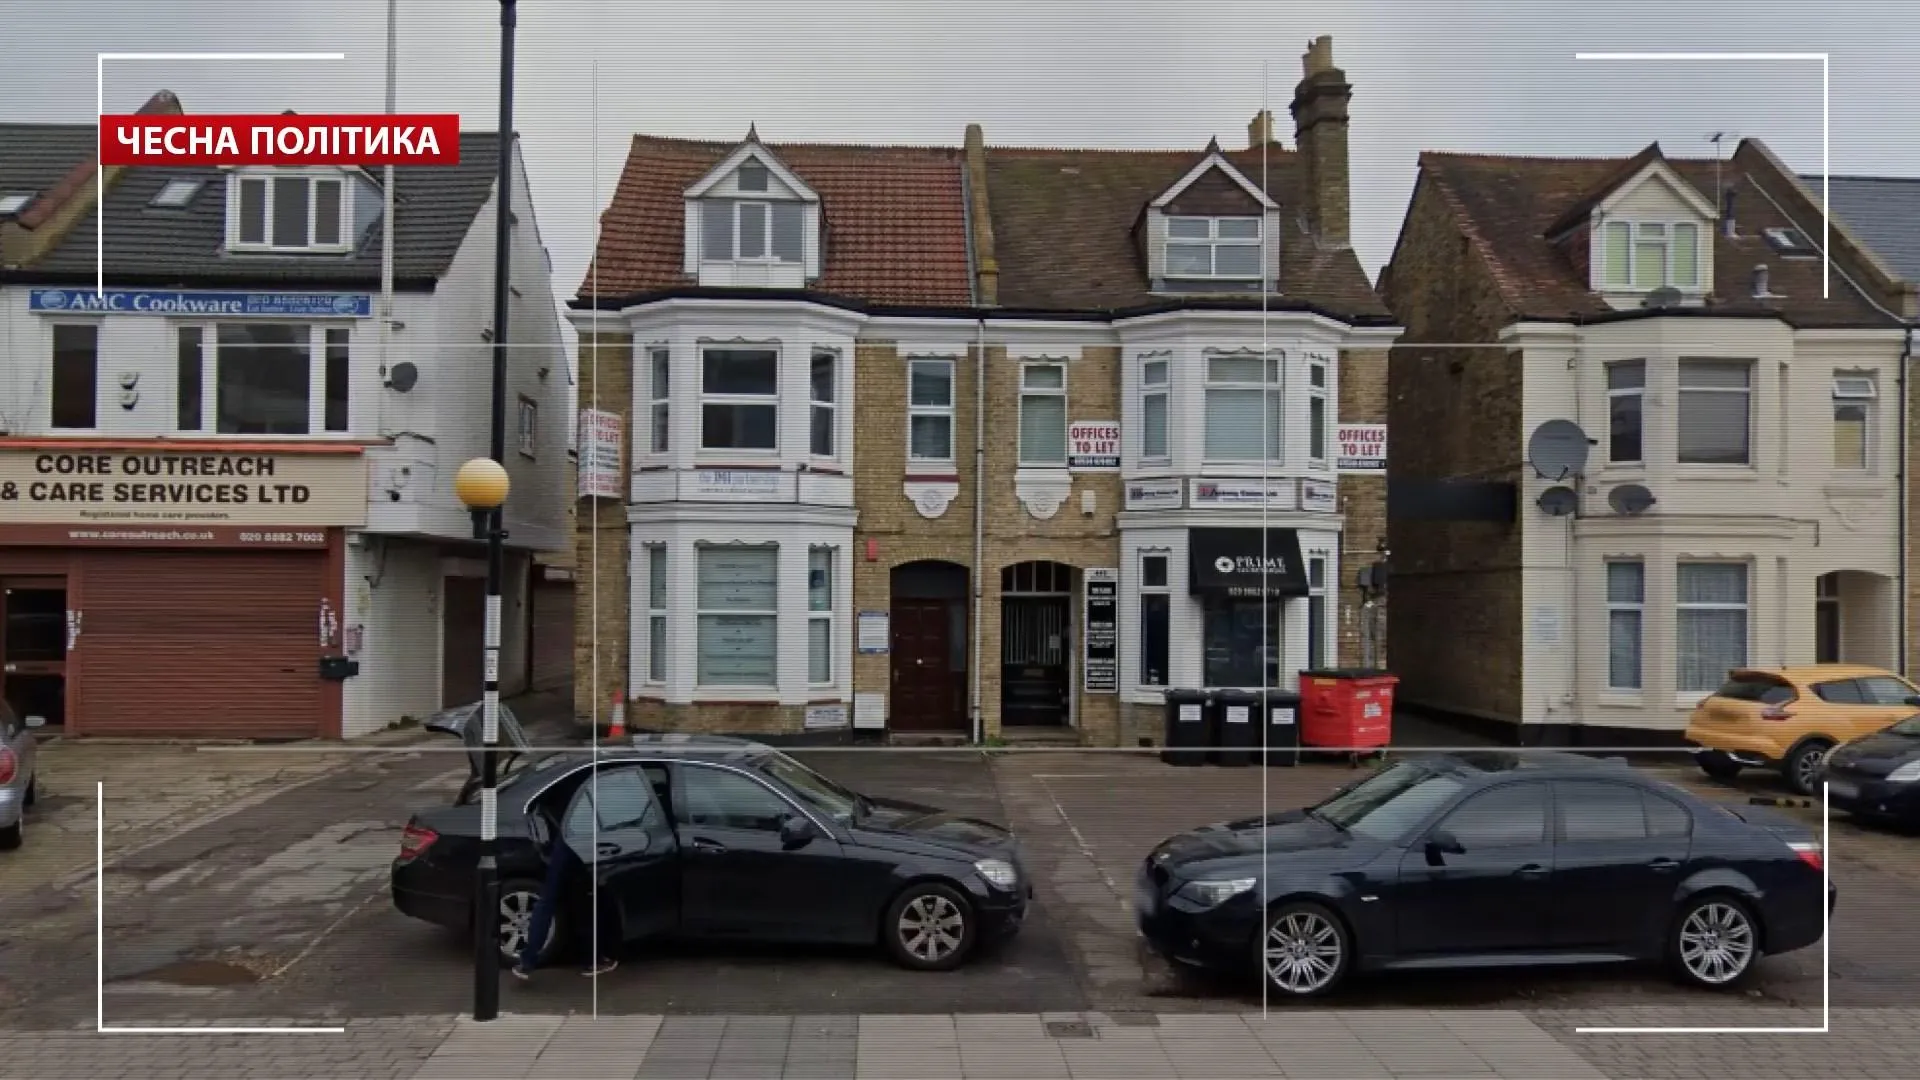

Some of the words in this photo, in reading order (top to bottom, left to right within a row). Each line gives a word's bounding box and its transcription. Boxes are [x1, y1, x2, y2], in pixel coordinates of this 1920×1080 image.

[70, 293, 125, 310] AMC
[133, 293, 242, 314] Cookware
[1072, 427, 1119, 440] OFFICES
[1339, 429, 1385, 442] OFFICES
[1076, 441, 1091, 454] TO
[1096, 441, 1114, 454] LET
[1341, 443, 1357, 456] TO
[1362, 443, 1381, 456] LET
[36, 454, 112, 474] CORE
[122, 456, 275, 476] OUTREACH
[1, 481, 18, 501] &
[29, 482, 104, 501] CARE
[113, 483, 249, 503] SERVICES
[258, 485, 311, 503] LTD
[134, 511, 159, 519] home
[162, 512, 183, 520] care
[239, 532, 262, 542] 020
